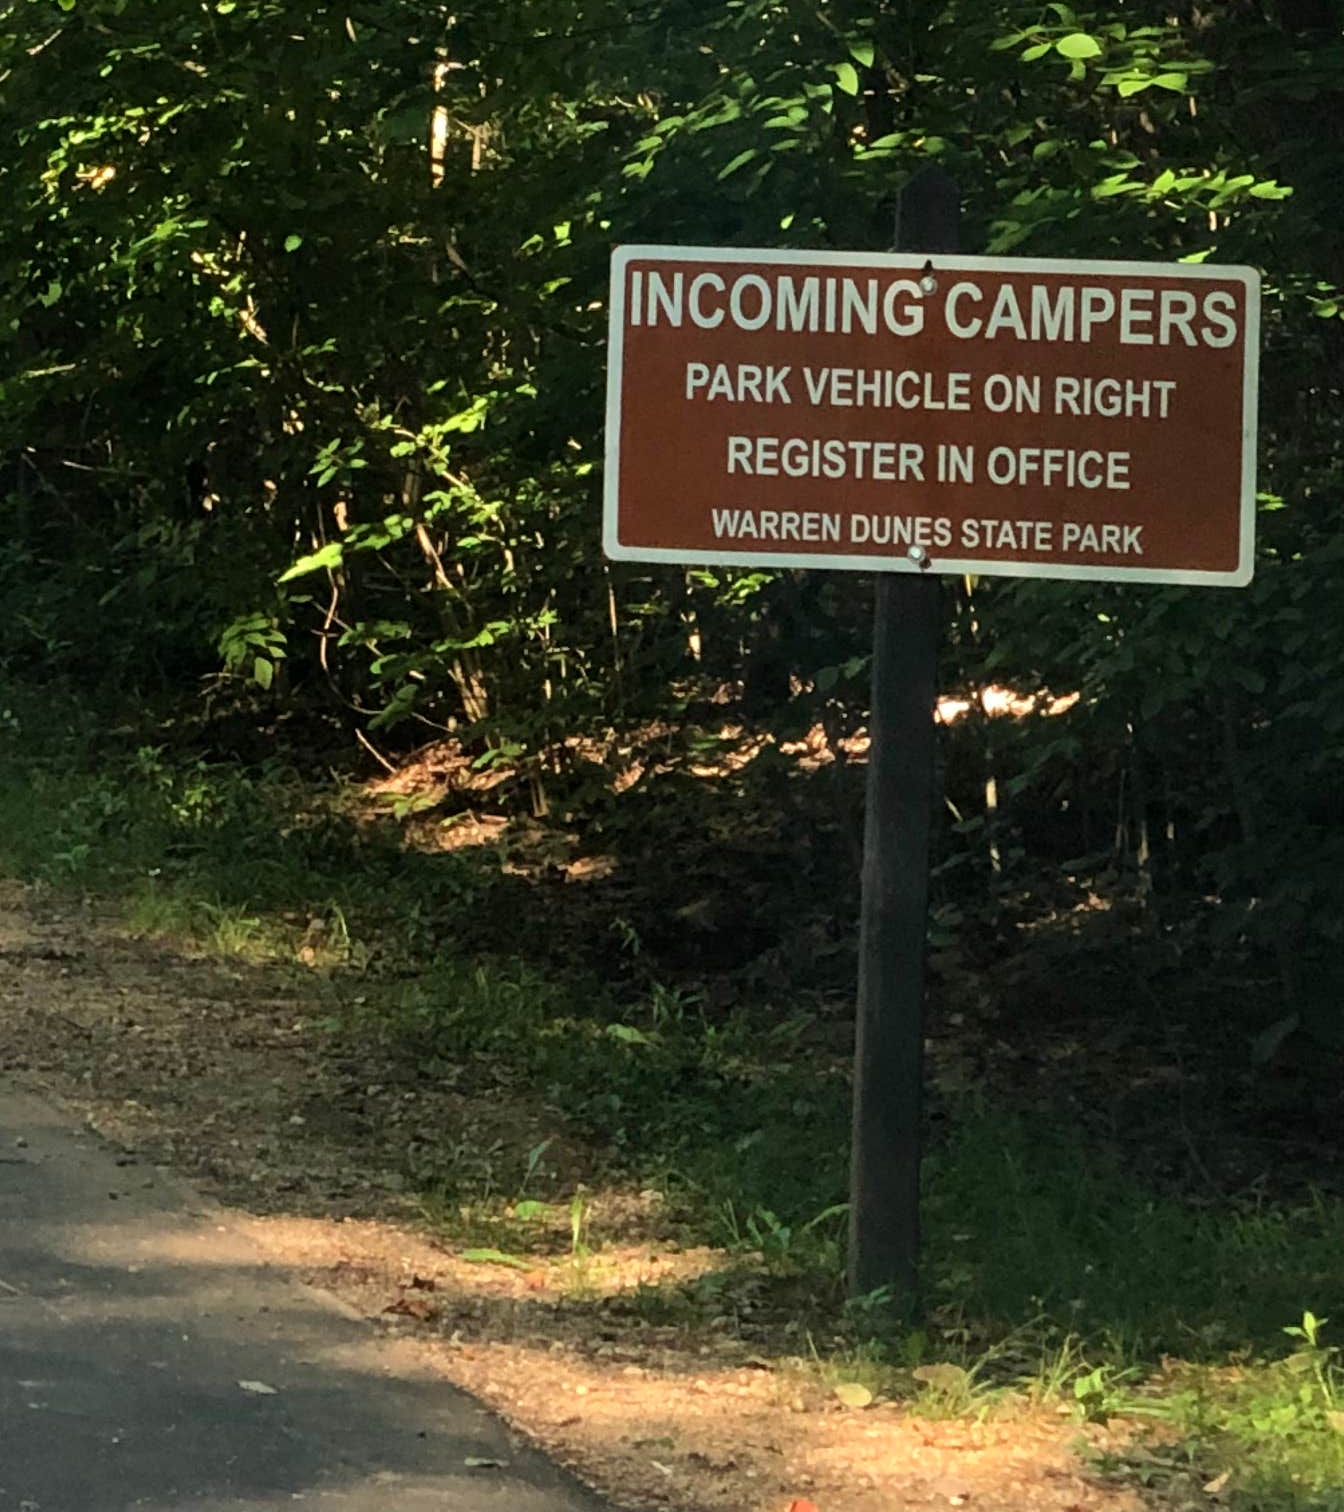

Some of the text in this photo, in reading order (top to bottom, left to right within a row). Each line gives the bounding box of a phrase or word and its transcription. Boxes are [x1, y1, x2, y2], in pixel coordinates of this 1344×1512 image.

[630, 270, 1238, 349] INCOMING CAMPERS
[685, 362, 1176, 419] PARK VEHICLE ON RIGHT
[726, 435, 1131, 490] REGISTER IN OFFICE
[712, 508, 1144, 556] WARREN DUNES STATE PARK
